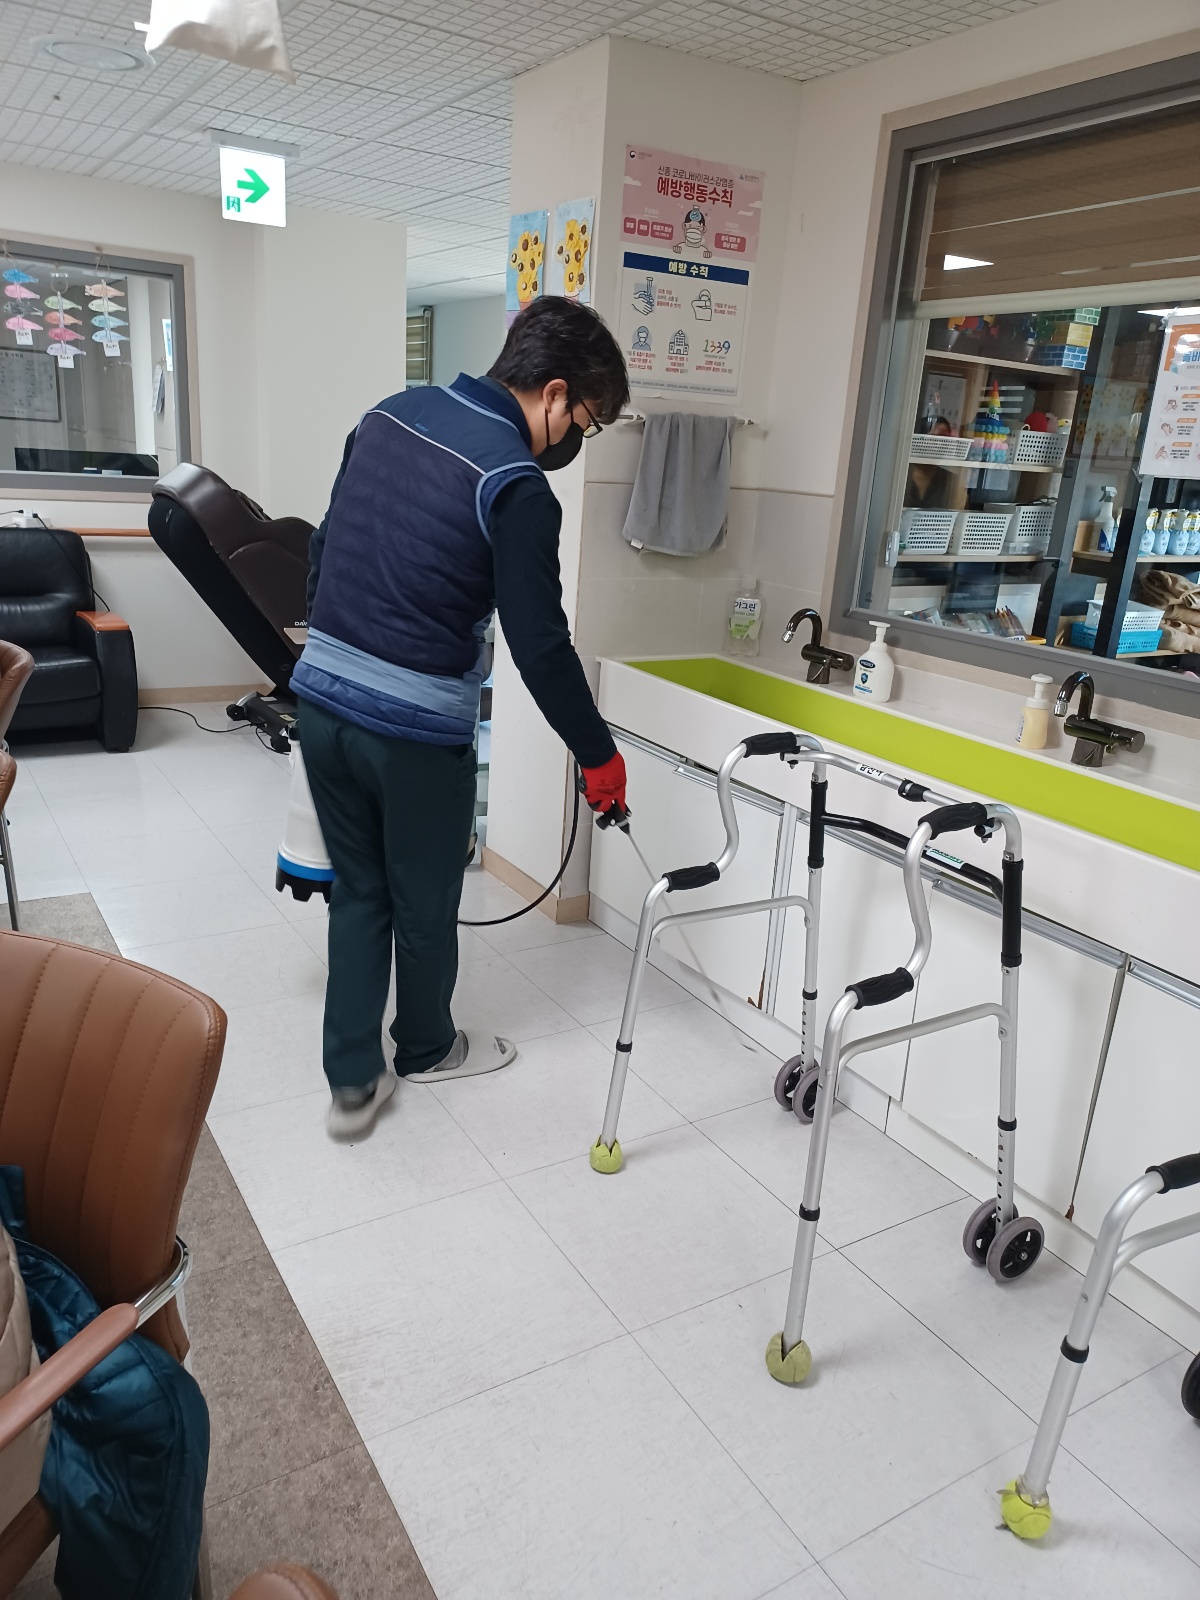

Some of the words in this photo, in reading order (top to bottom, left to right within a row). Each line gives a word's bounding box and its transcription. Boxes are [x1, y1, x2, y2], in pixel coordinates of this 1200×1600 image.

[658, 165, 671, 177] 신종
[672, 168, 735, 189] 코로나바이러스감염증
[657, 176, 733, 208] 예방행동수칙
[668, 261, 688, 275] 예방
[690, 264, 709, 278] 수칙
[702, 339, 731, 355] 1339
[734, 601, 756, 612] 가그린
